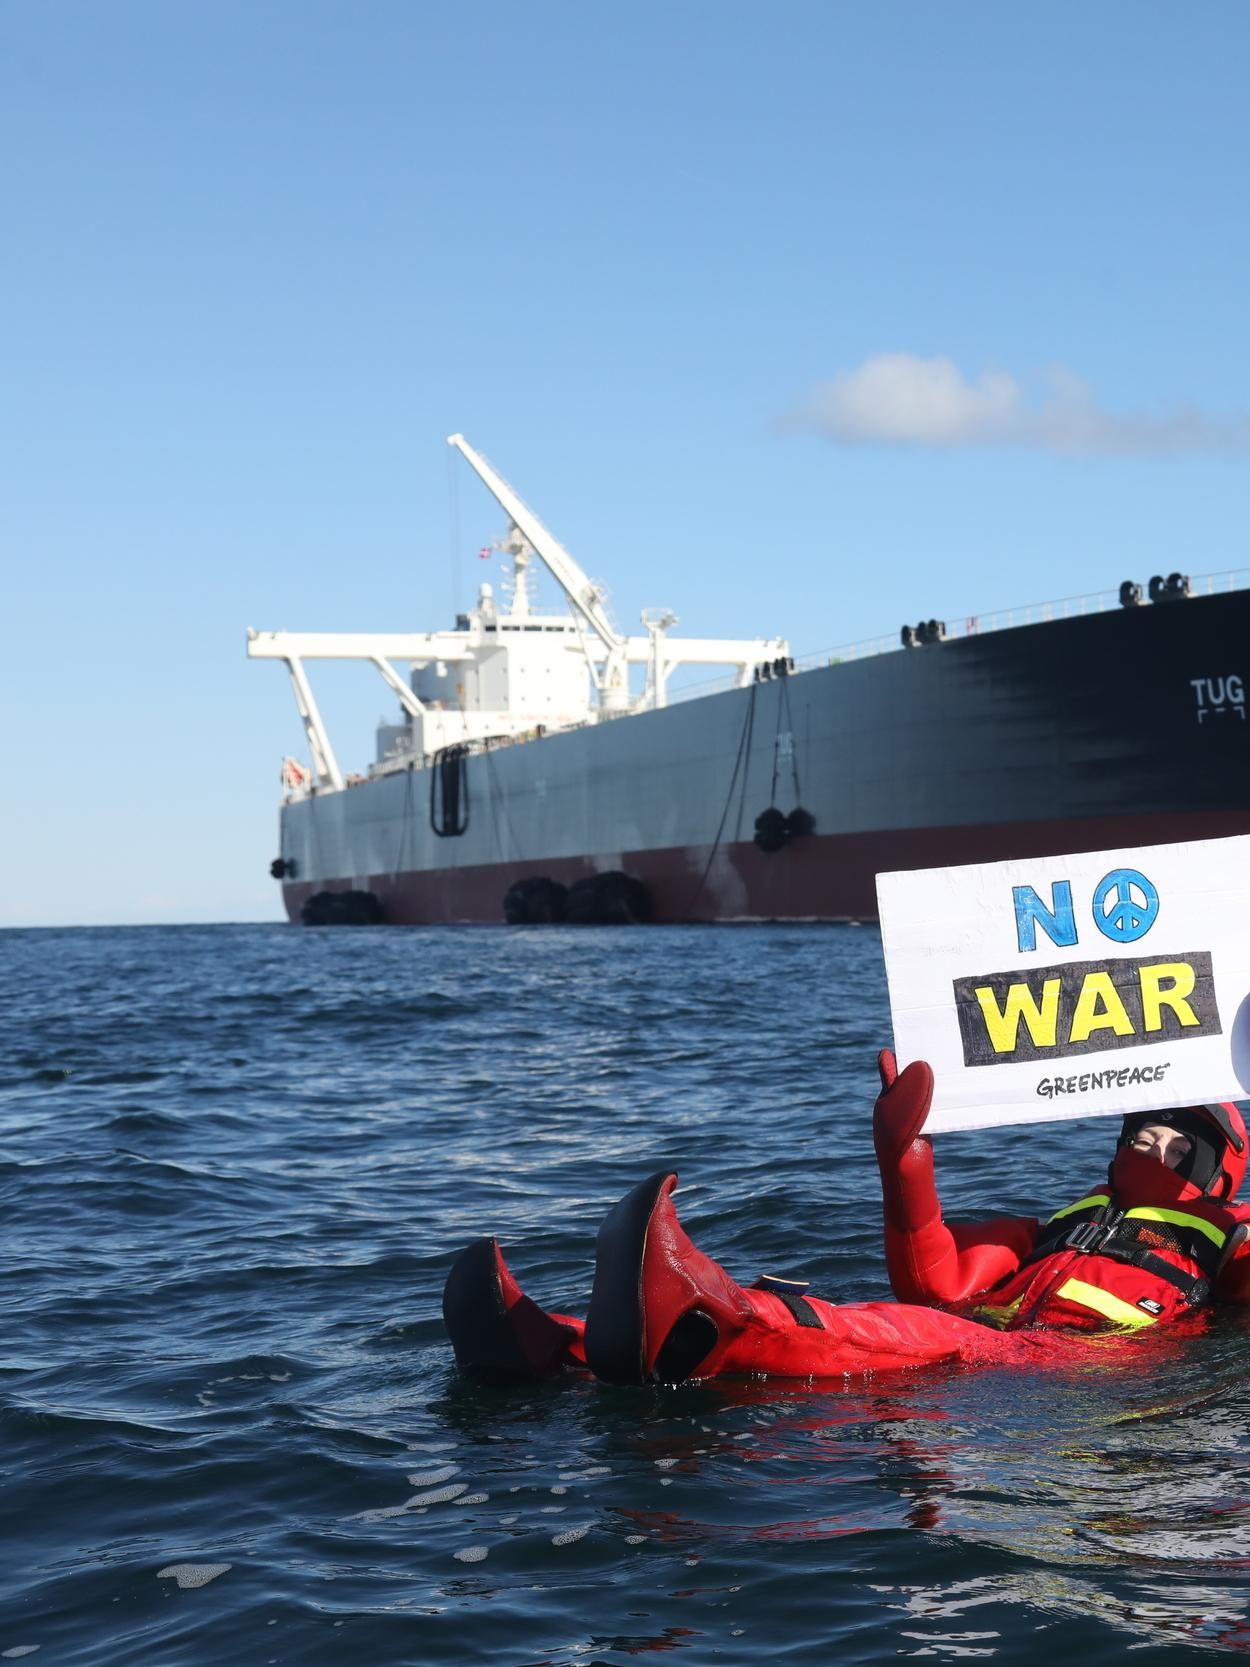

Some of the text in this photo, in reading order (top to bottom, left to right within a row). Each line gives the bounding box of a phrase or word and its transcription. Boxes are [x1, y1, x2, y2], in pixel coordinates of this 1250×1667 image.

[1190, 675, 1246, 706] TUG
[974, 962, 1201, 1054] WAR
[1036, 1062, 1171, 1099] GREENPEACE
